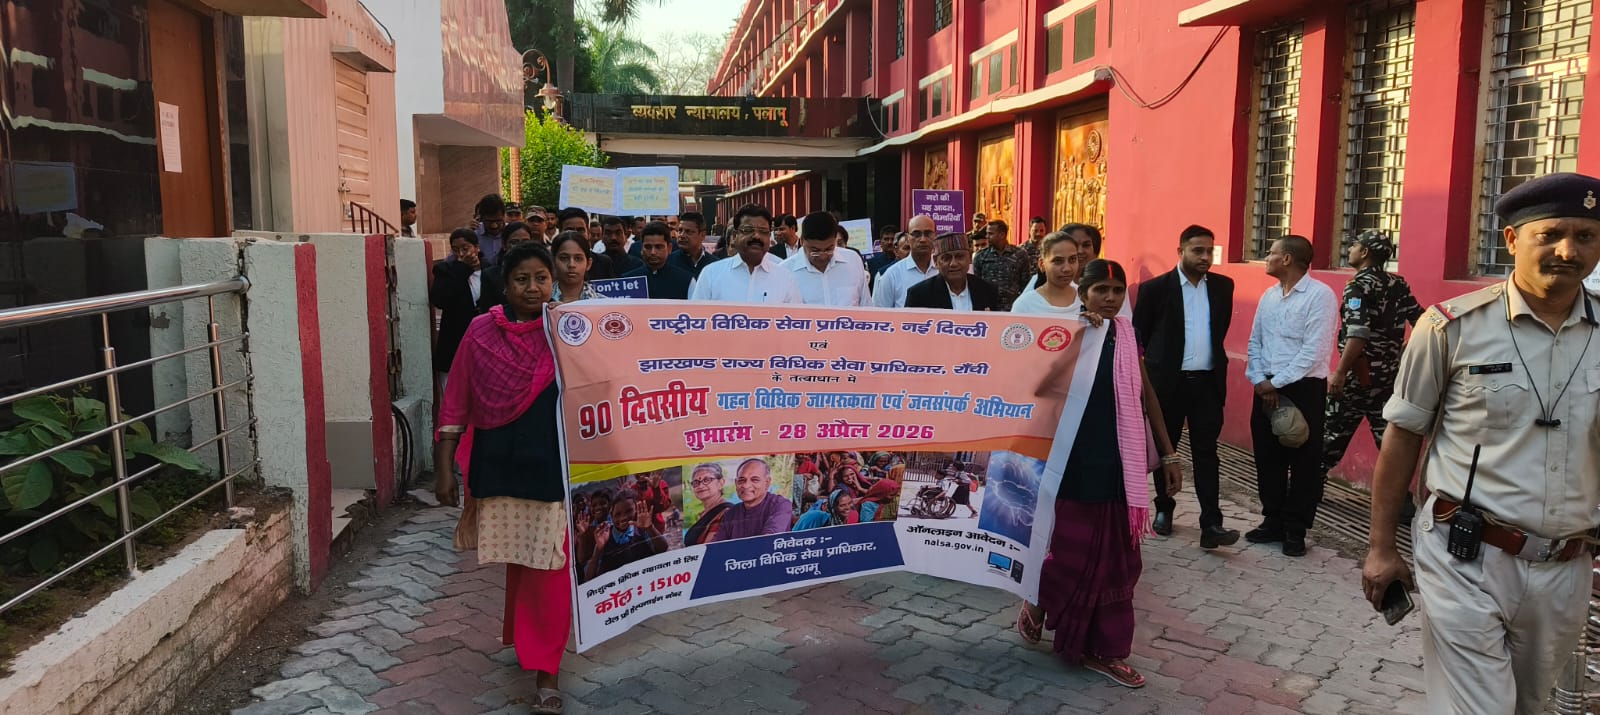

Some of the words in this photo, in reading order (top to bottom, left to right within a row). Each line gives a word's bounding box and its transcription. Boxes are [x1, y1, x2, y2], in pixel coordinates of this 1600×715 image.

[631, 105, 677, 120] व्यवहार
[752, 106, 788, 127] पलामू
[623, 280, 639, 290] let
[648, 314, 706, 334] राष्ट्रीय
[712, 313, 770, 331] विधिक
[775, 315, 812, 331] सेवा
[816, 317, 895, 333] प्राधिकार,
[902, 319, 933, 335] नई
[936, 320, 989, 338] दिल्ली
[809, 340, 828, 351] एवं
[639, 358, 717, 373] झारखण्ड
[722, 358, 764, 369] राज्य
[769, 355, 827, 370] विधिक
[831, 356, 867, 371] सेवा
[870, 359, 946, 375] प्राधिकार,
[772, 372, 782, 383] के
[580, 401, 612, 439] 90
[619, 380, 710, 428] दिवसीय
[717, 392, 752, 410] गहन
[755, 388, 802, 409] विधिक
[882, 390, 906, 410] एवं
[909, 391, 970, 412] जनसंपर्क
[973, 395, 1034, 419] अभियान
[685, 422, 752, 451] शुभारंभ
[779, 423, 807, 439] 28
[817, 419, 870, 439] अप्रैल
[878, 424, 935, 439] 2026
[773, 536, 816, 550] निवेदक
[906, 525, 963, 538] ऑनलाइन
[965, 531, 1007, 548] आवेदन
[924, 538, 984, 553] nalsa.gov.in
[725, 558, 757, 572] जिला
[760, 551, 799, 567] विधिक
[801, 548, 824, 560] सेवा
[785, 561, 822, 576] पलामू
[594, 588, 634, 615] कॉल
[650, 571, 692, 592] 15100
